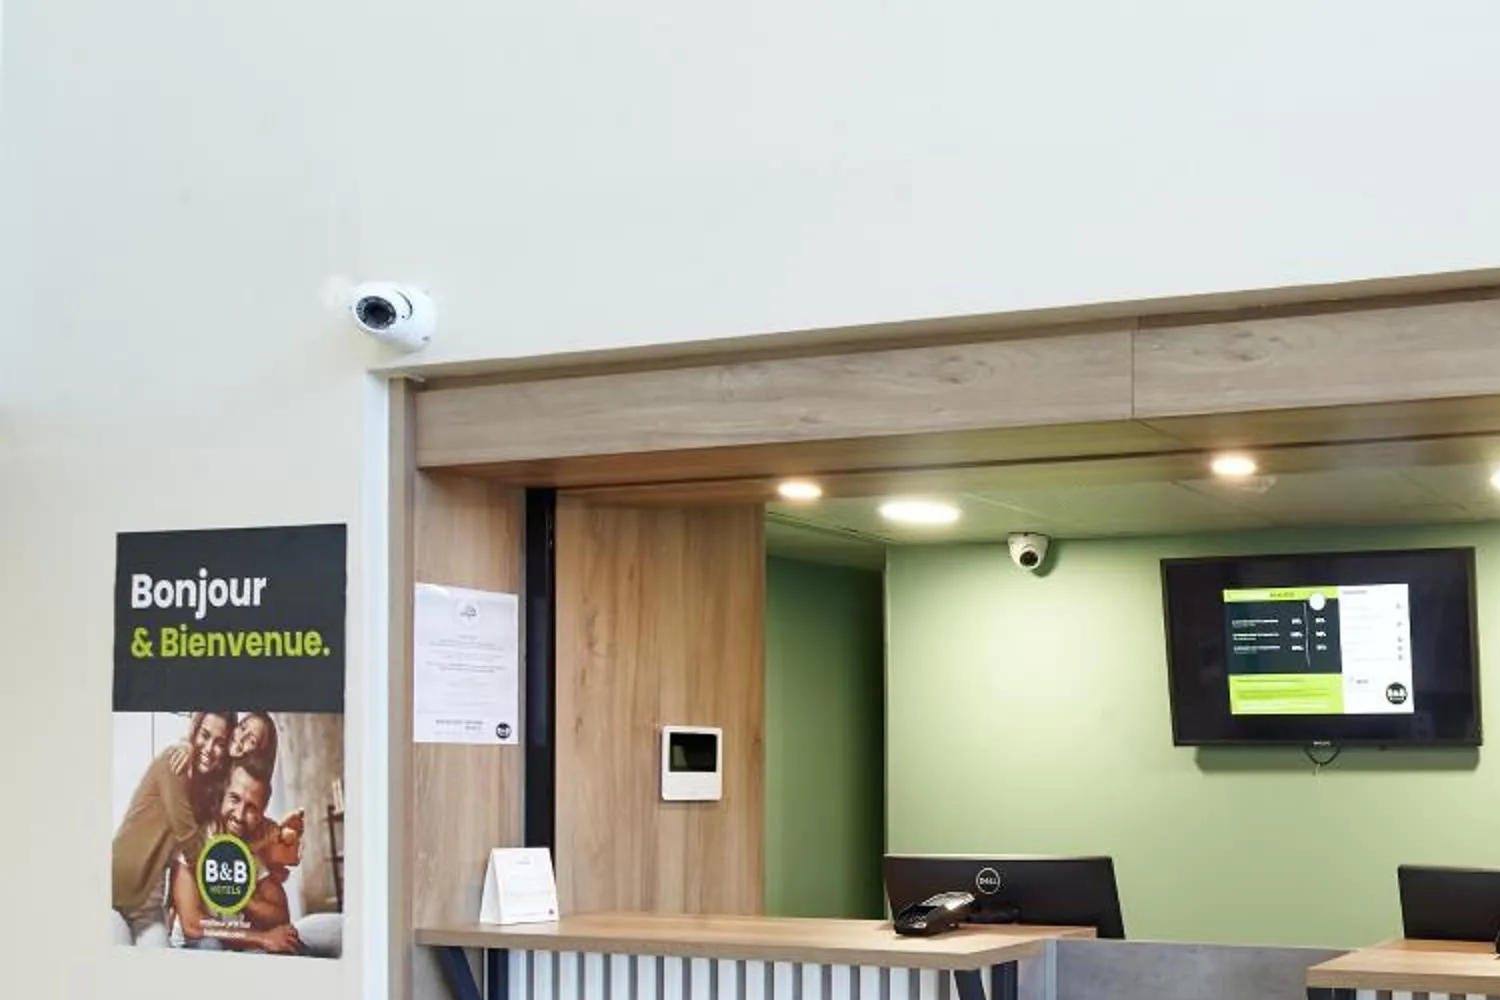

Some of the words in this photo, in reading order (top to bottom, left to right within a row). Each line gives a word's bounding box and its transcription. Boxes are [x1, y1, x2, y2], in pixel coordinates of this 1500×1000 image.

[131, 568, 267, 620] Bonjour
[131, 626, 154, 658] &
[160, 623, 331, 658] Bienvenue.
[205, 859, 248, 884] B&B
